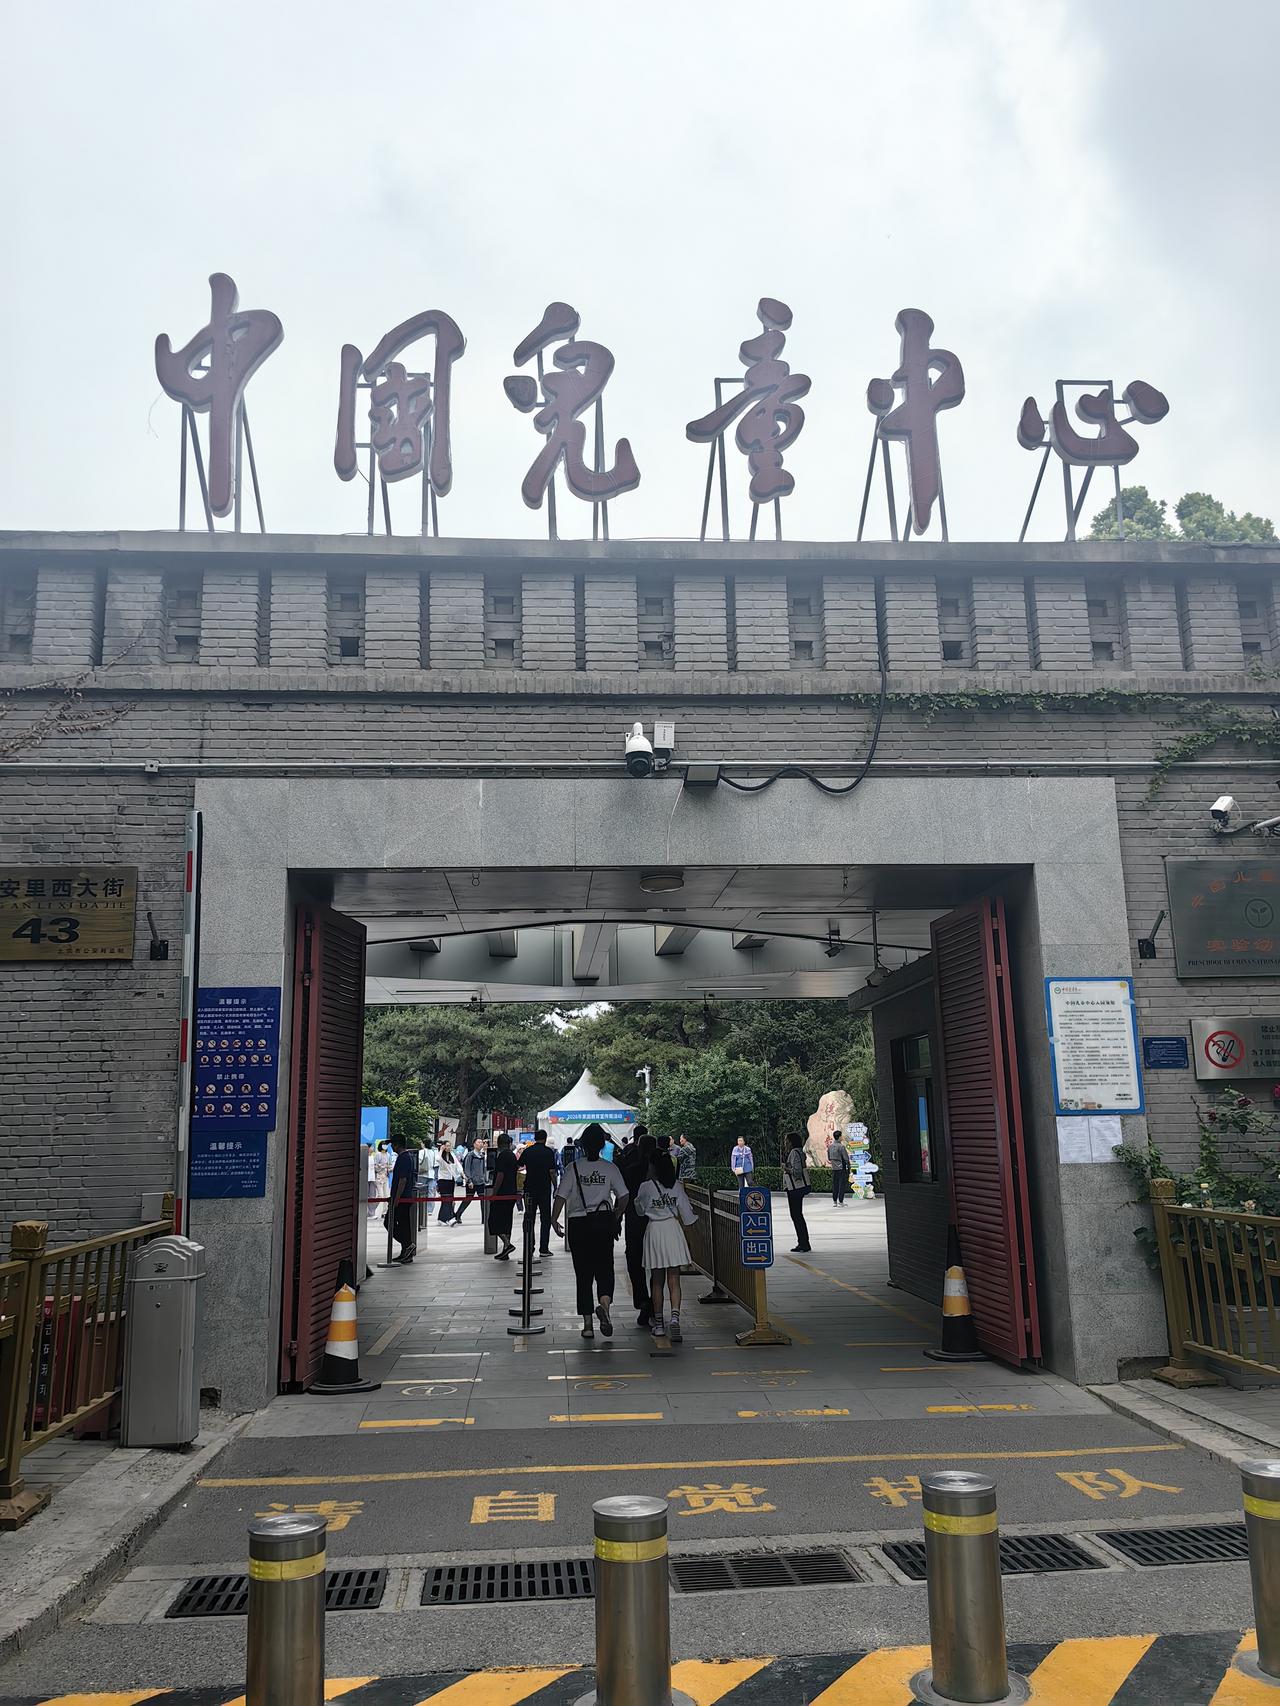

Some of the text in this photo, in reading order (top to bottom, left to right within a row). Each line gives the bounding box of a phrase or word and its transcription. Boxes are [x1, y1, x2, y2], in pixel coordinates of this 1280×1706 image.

[0, 878, 124, 898] 安里西大街
[12, 917, 80, 943] 43
[209, 1141, 242, 1151] 温馨提示
[746, 1215, 767, 1227] 入口
[747, 1242, 768, 1254] 出口
